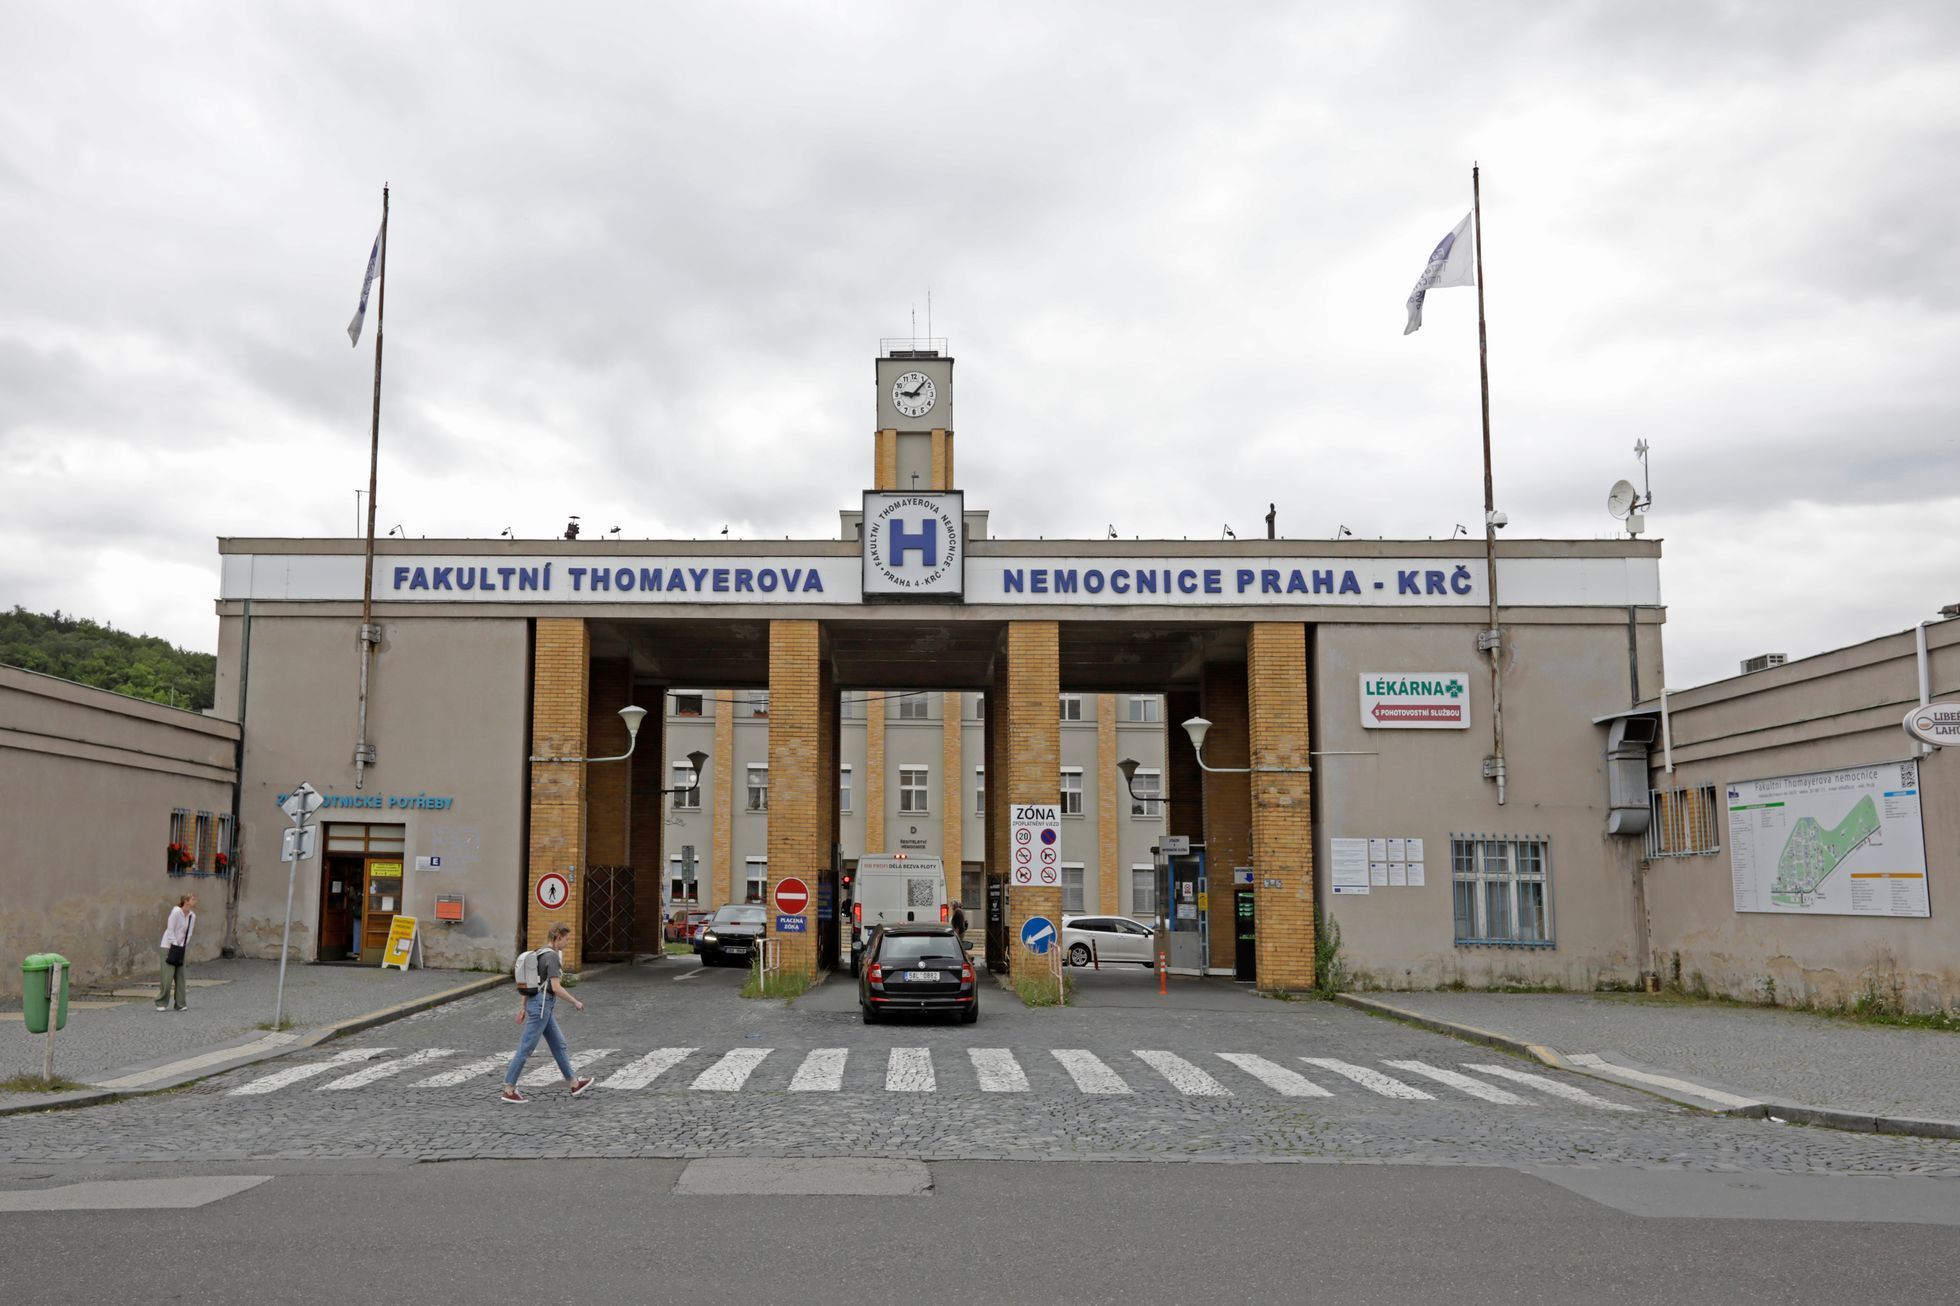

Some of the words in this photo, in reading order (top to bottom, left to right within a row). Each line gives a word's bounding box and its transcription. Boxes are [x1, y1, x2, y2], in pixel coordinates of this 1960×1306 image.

[870, 522, 882, 567] FAKULTNÍ
[879, 498, 939, 520] THOMAYEROVA
[941, 514, 956, 568] NEMOCNICE
[889, 518, 937, 567] H
[393, 562, 552, 590] FAKULTNÍ
[568, 567, 824, 593] THOMAYEROVA
[883, 570, 911, 587] PRAHA
[1003, 568, 1222, 594] NEMOCNICE
[1237, 569, 1361, 595] PRAHA
[1398, 565, 1472, 595] KRČ
[1366, 677, 1445, 696] LÉKÁRNA
[1381, 708, 1429, 716] POHOTOVOSTNÍ
[1430, 708, 1460, 717] SLUŽBOU
[1784, 776, 1832, 789] Thomayerova
[1834, 769, 1878, 783] nemocnice
[388, 793, 454, 810] POTŘEBY
[1016, 805, 1056, 820] ZÓNA
[910, 826, 917, 834] D
[1019, 832, 1028, 841] 20
